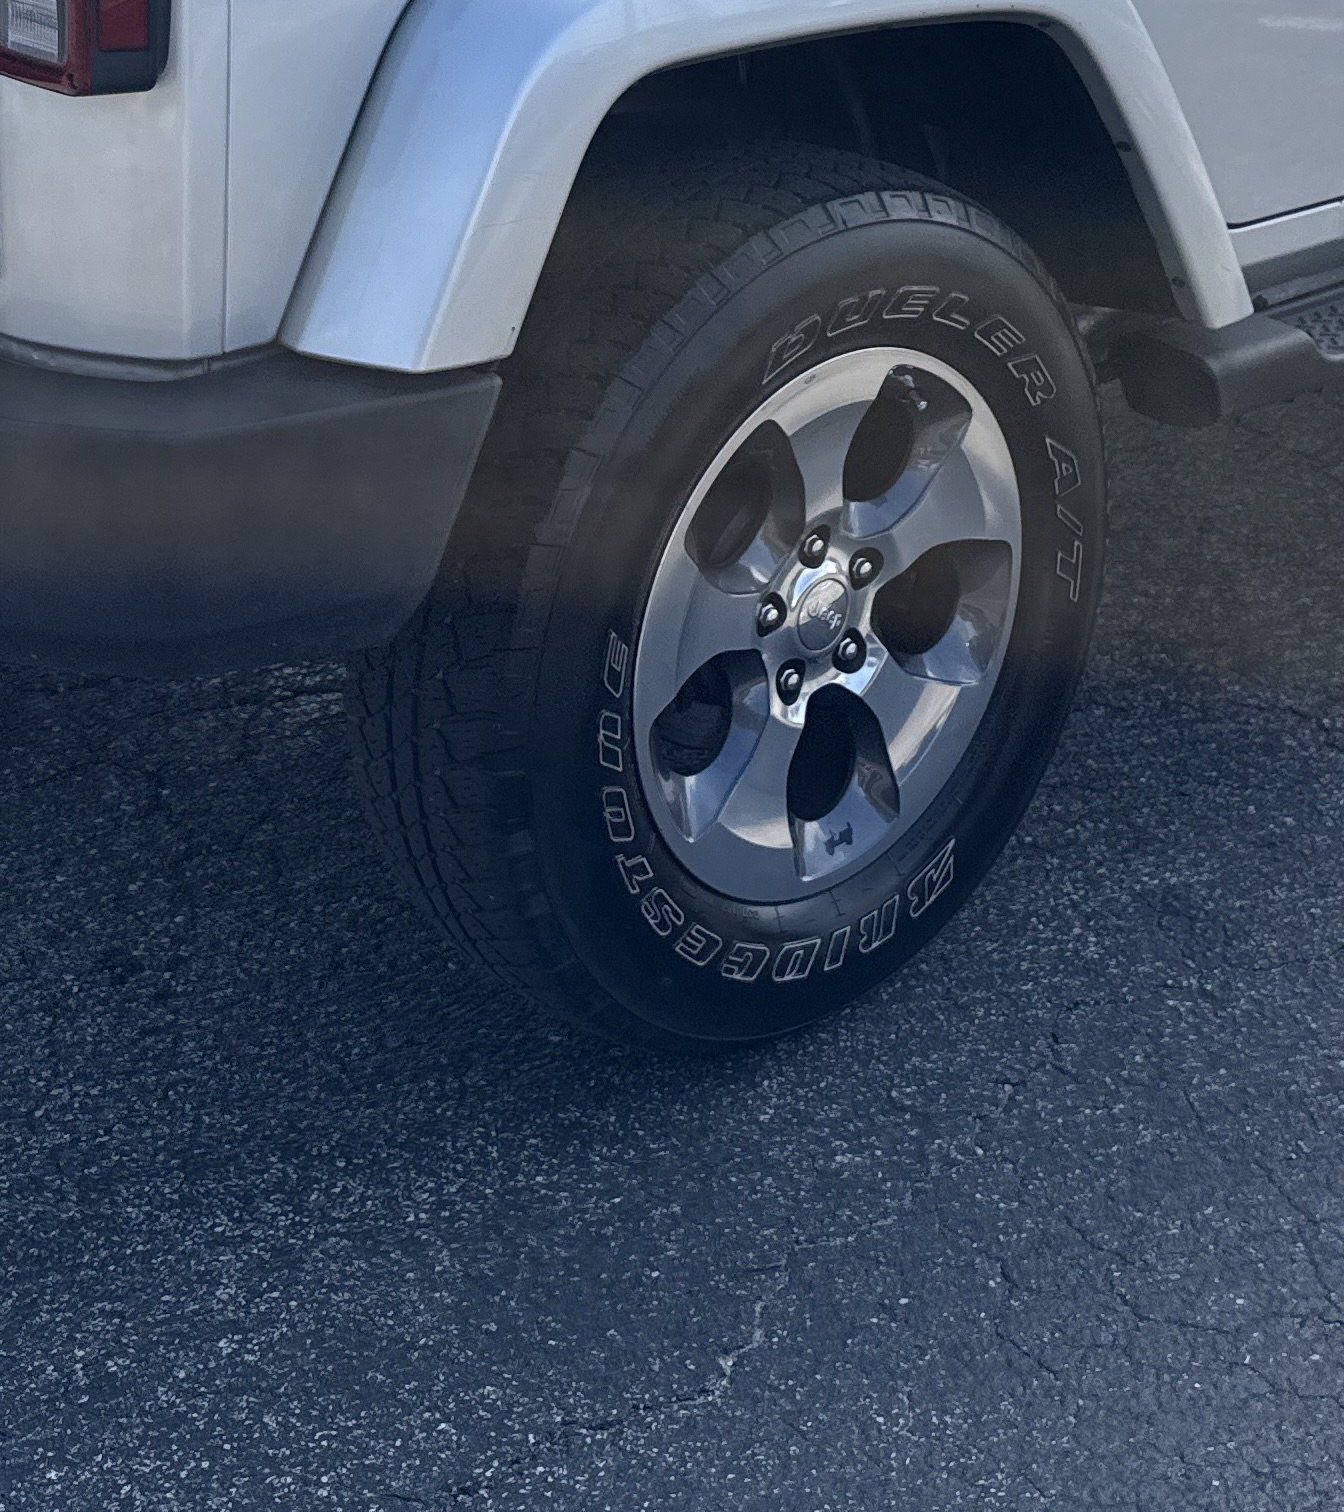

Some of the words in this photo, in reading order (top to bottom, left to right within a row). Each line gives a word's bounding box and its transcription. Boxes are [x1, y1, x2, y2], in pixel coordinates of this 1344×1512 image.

[761, 285, 1057, 406] DUELER
[1044, 434, 1084, 602] A/T
[597, 629, 957, 982] BRIDGESTONE
